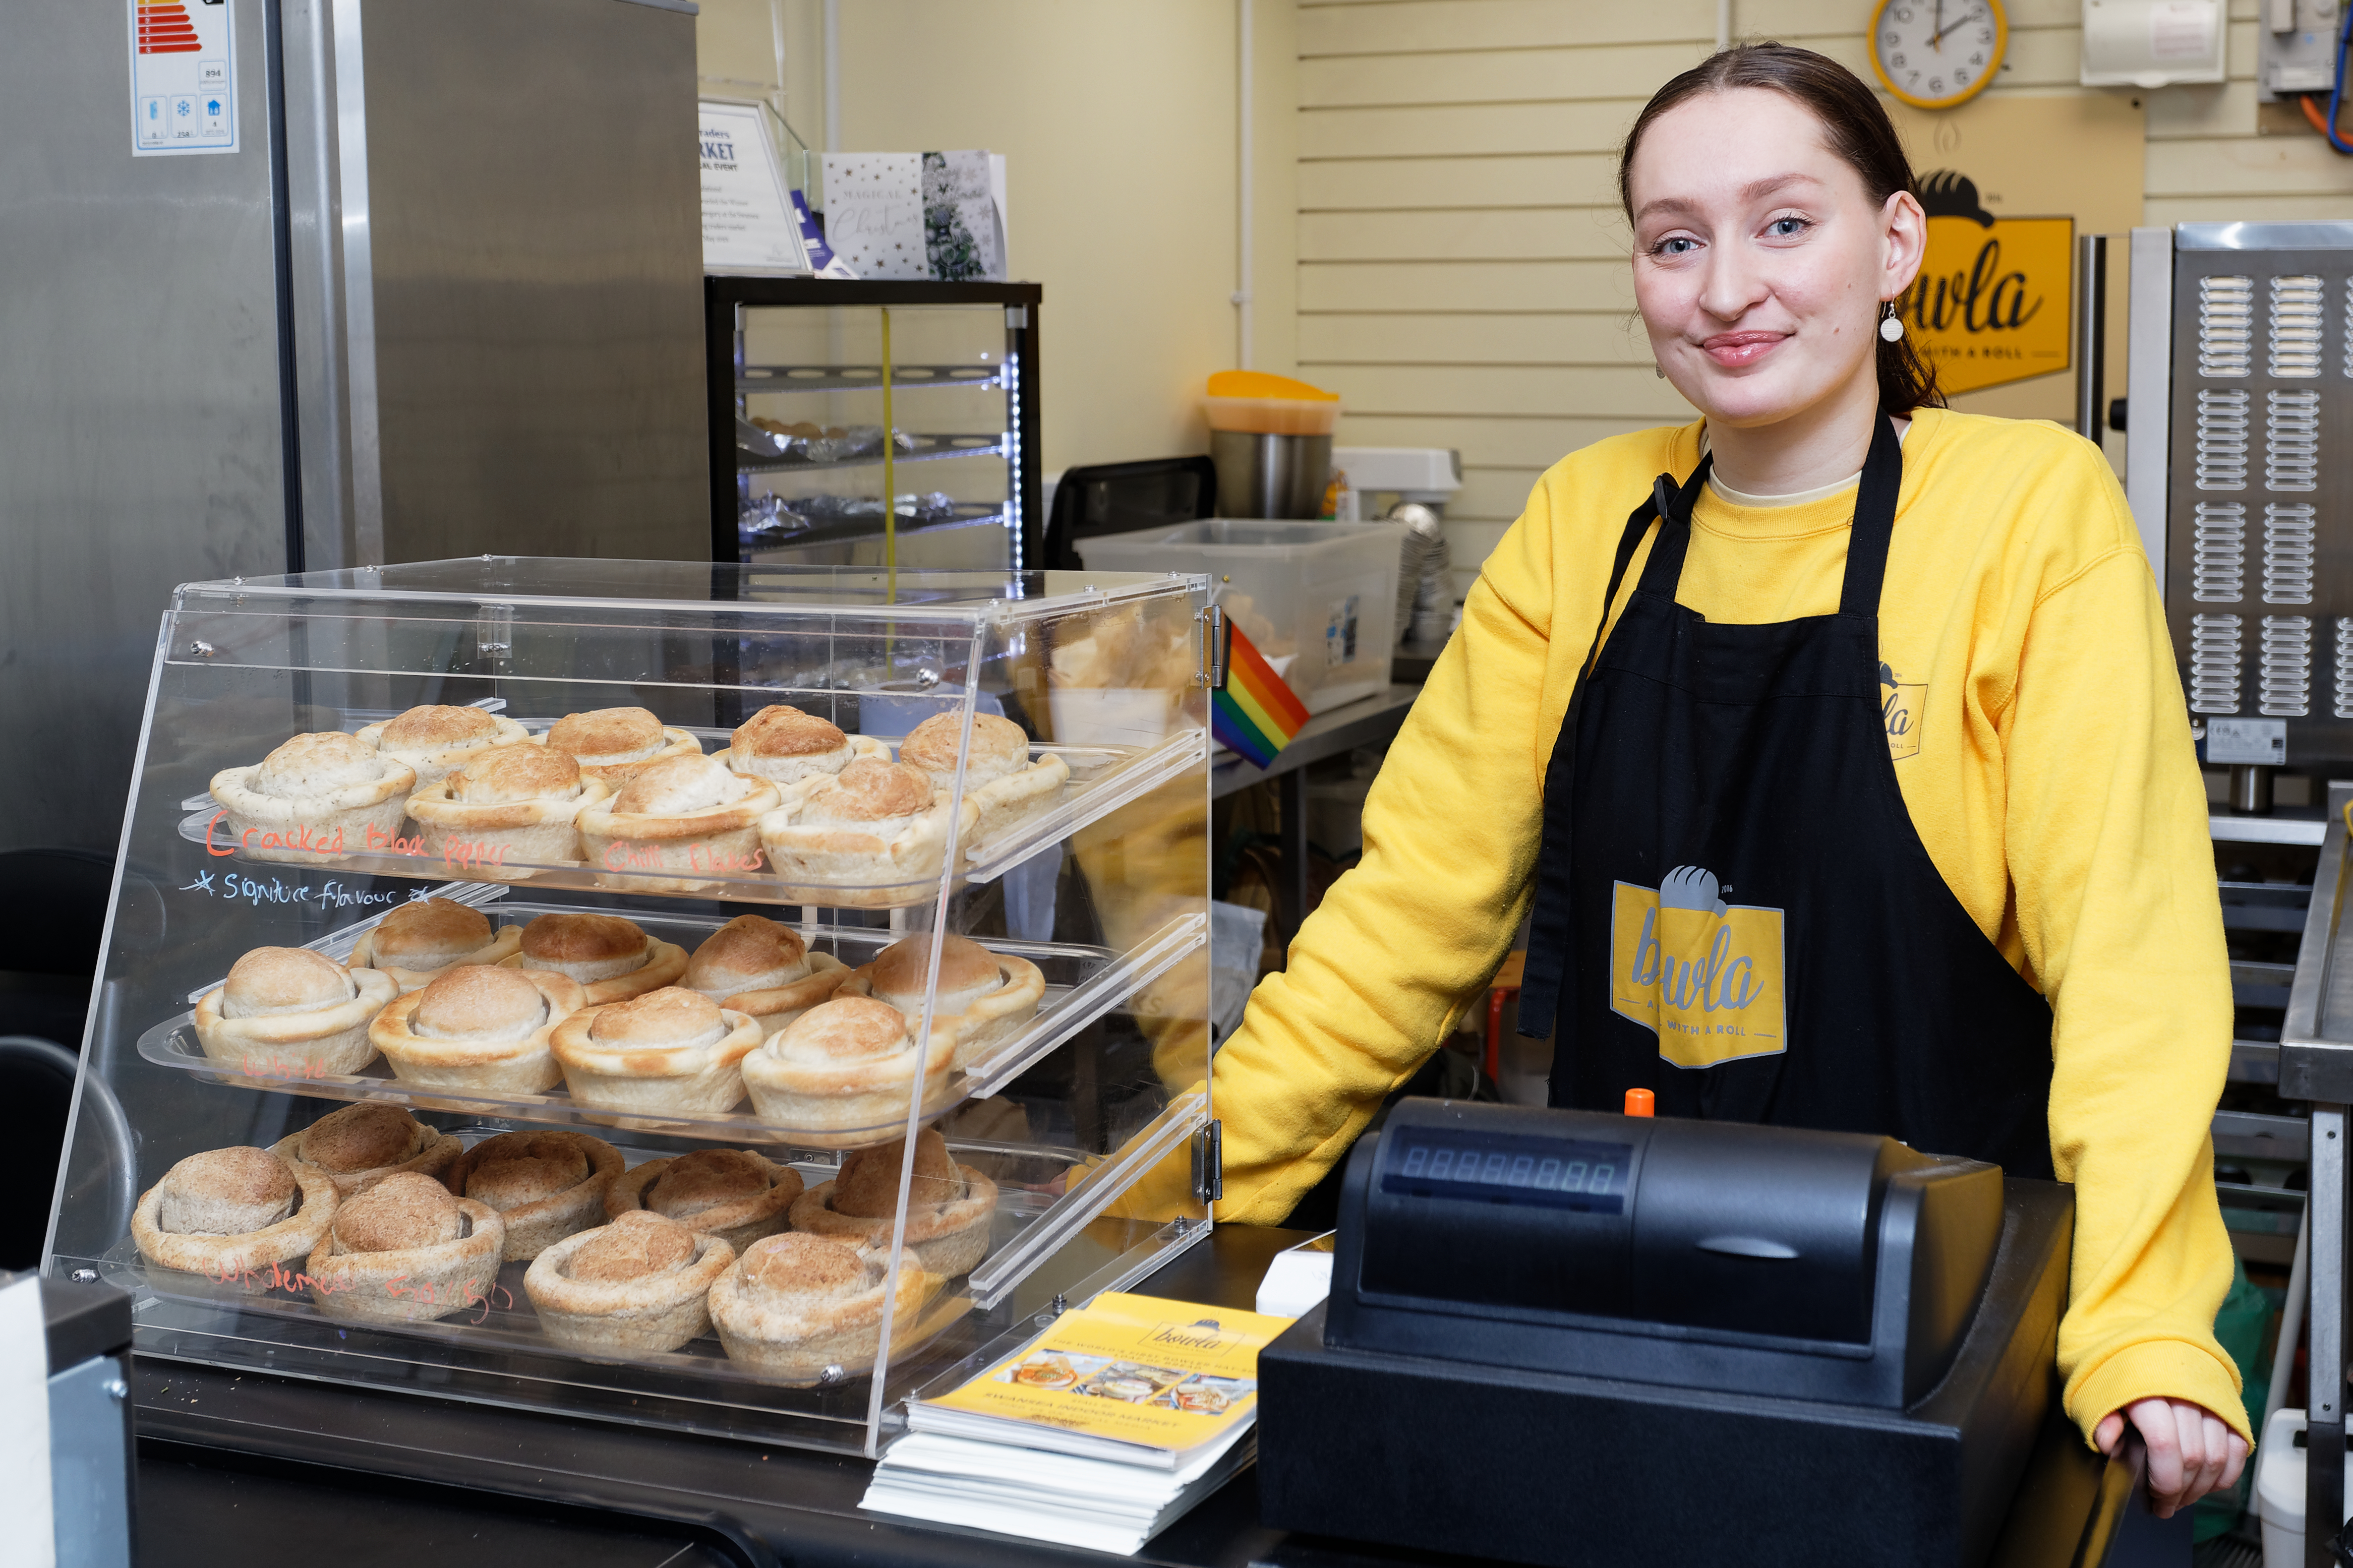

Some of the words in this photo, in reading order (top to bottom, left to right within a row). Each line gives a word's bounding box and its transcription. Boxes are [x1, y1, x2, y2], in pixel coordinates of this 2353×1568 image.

[699, 129, 730, 139] raders
[1912, 238, 2043, 333] wla
[1721, 884, 1733, 894] 2016
[1647, 1000, 1654, 1009] A
[1667, 1019, 1699, 1035] WITH
[1705, 1027, 1712, 1035] A
[1717, 1024, 1746, 1036] ROLL
